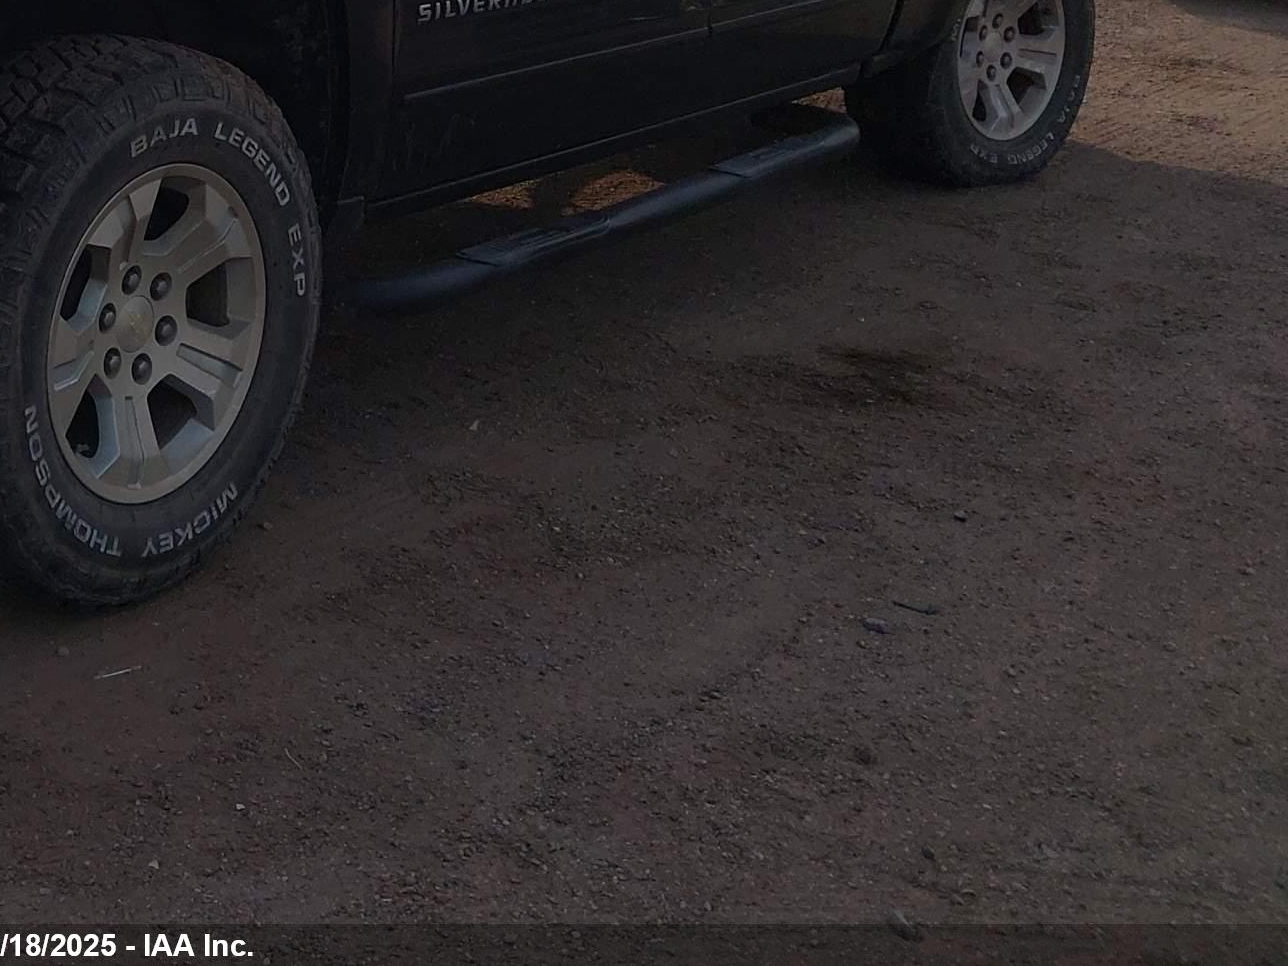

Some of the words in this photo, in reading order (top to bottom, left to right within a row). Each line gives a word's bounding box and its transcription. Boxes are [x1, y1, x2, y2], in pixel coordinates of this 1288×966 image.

[130, 117, 199, 158] BAJA
[214, 121, 291, 207] LEGEND
[287, 222, 306, 297] EXP
[24, 404, 122, 557] THOMPSON
[141, 481, 239, 558] MICKEY
